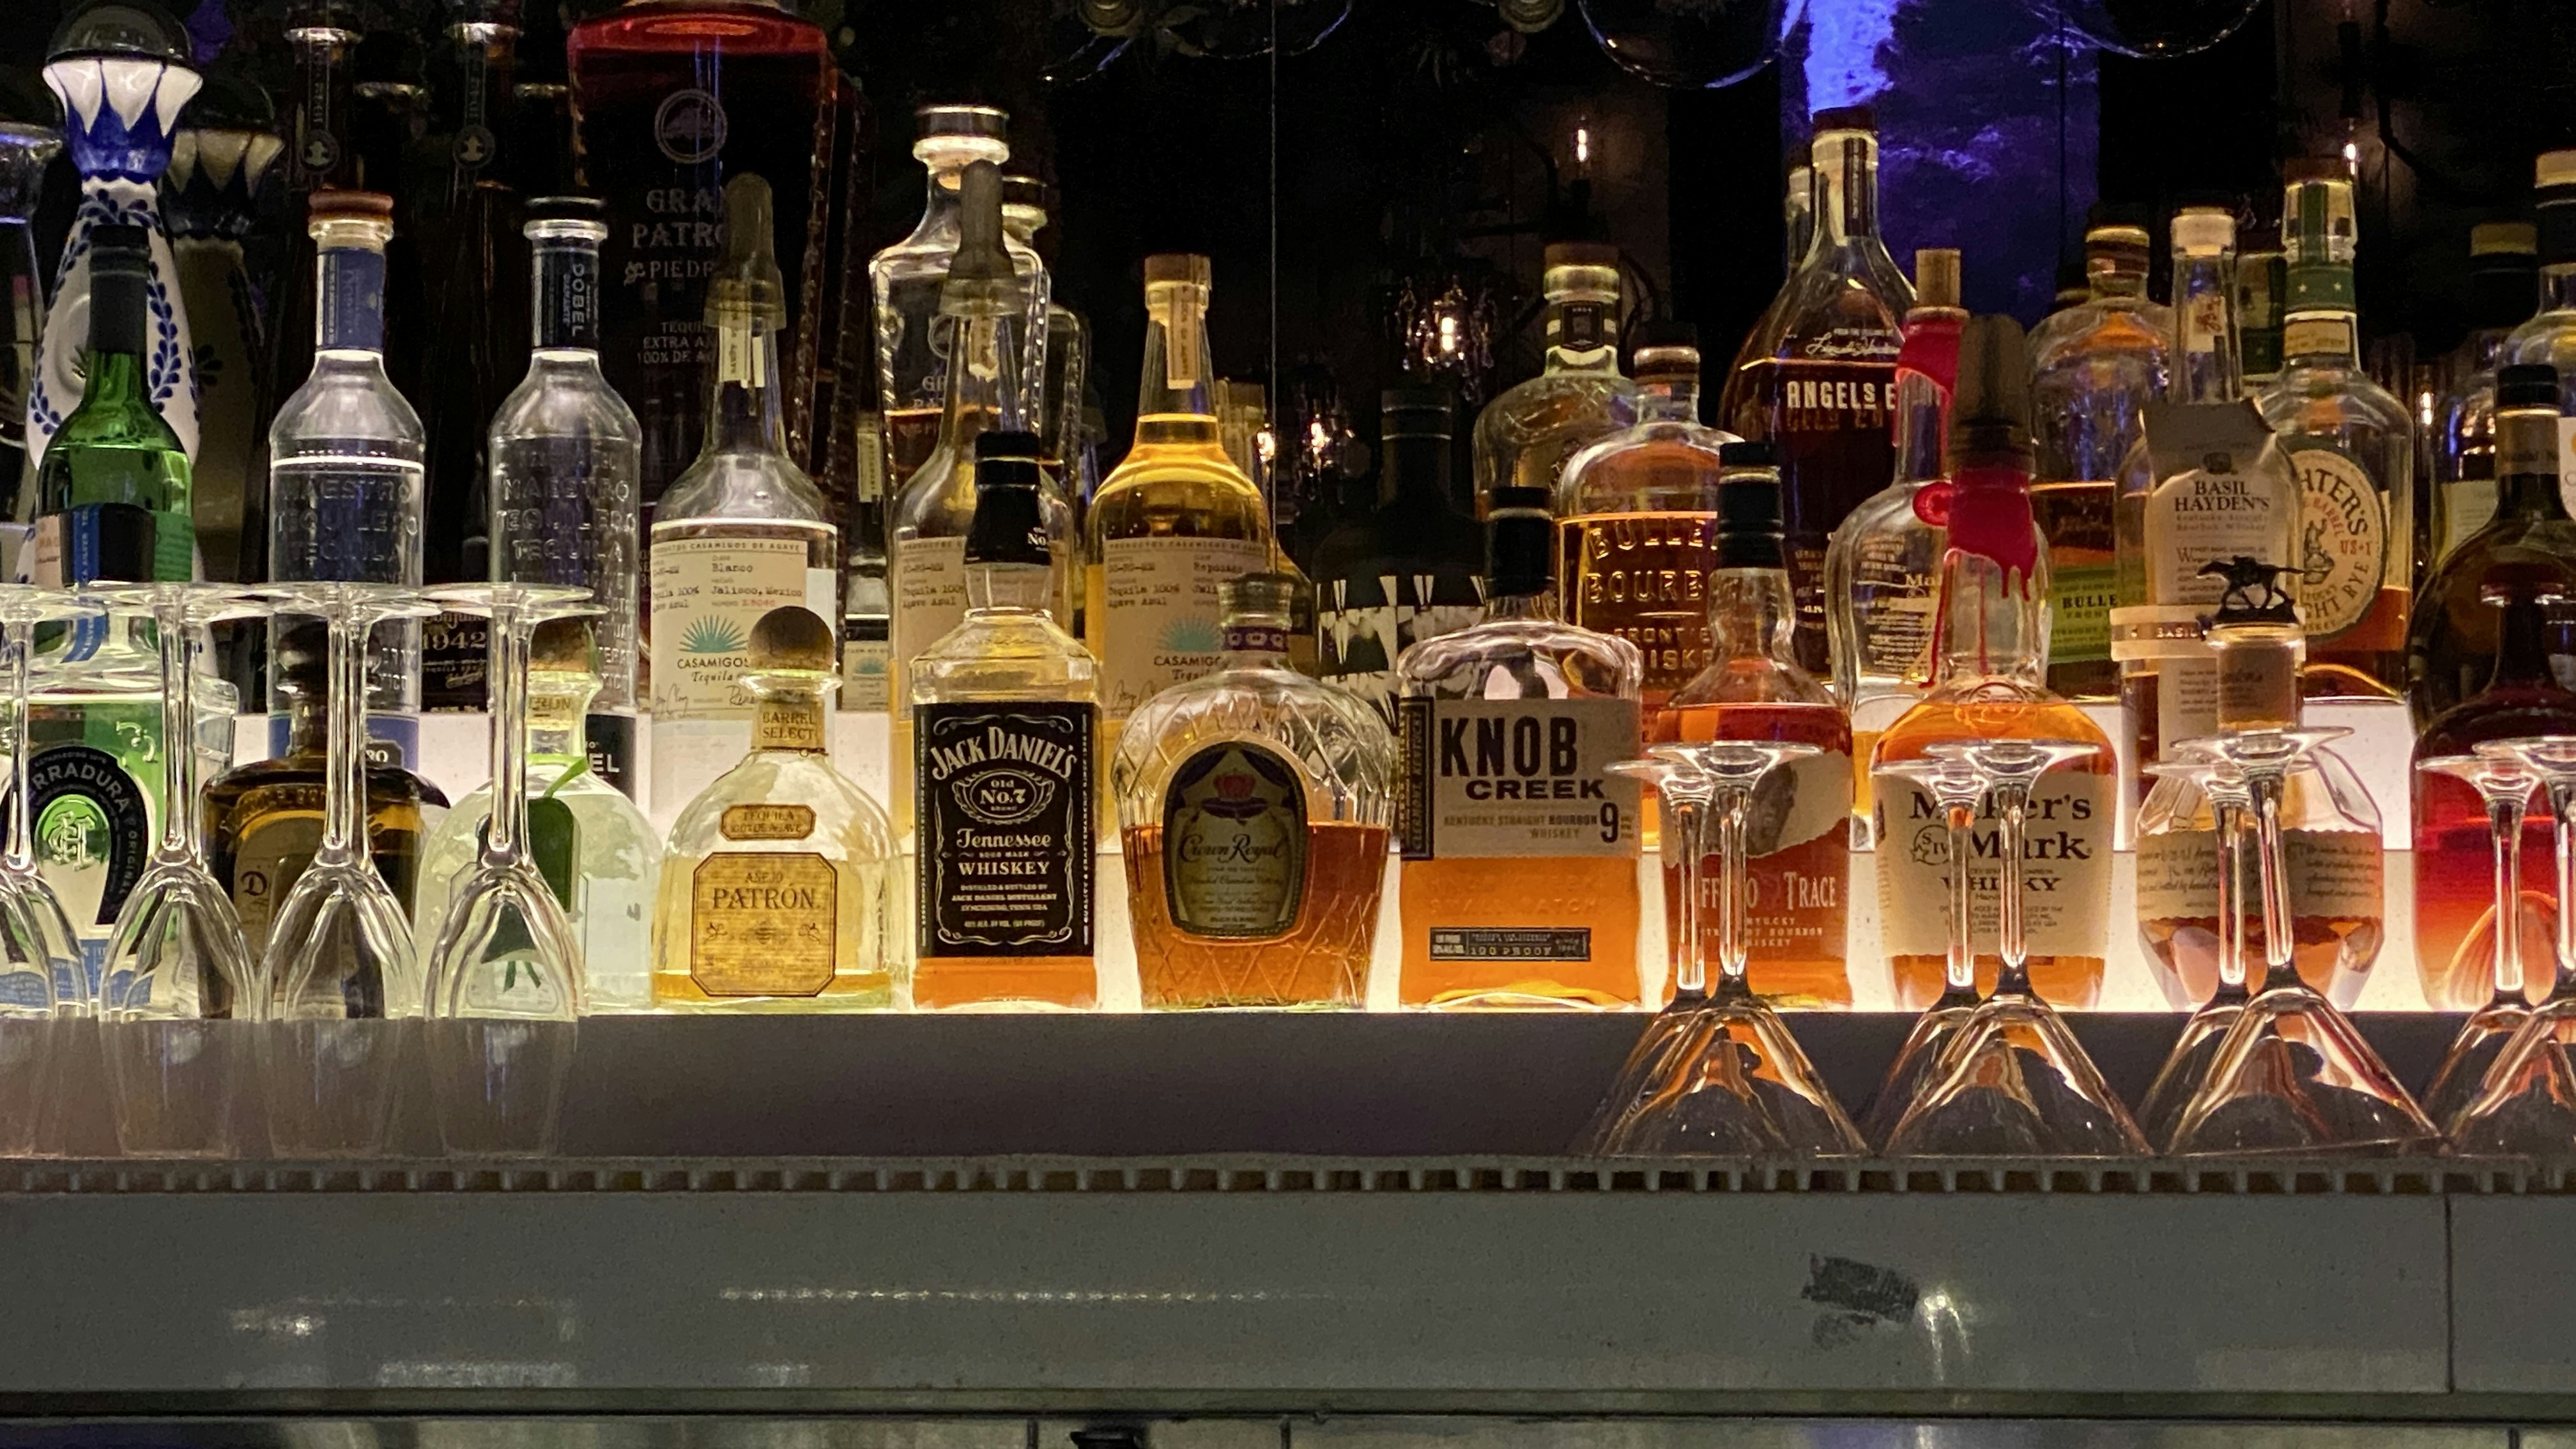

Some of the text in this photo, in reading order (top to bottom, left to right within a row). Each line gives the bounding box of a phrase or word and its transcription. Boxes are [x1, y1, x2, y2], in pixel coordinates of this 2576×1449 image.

[572, 263, 585, 337] DOBEL
[643, 337, 689, 349] EXTRA
[1787, 381, 1876, 410] ANGELS
[2195, 480, 2250, 496] BASIL
[2175, 496, 2270, 512] HAYDEN'S
[1589, 519, 1706, 560] BULLE
[711, 563, 754, 572] Blanco
[2342, 561, 2370, 599] RYE
[710, 586, 803, 597] Jalisco, Mexico
[1153, 583, 1180, 594] 100%
[422, 631, 487, 651] 1942
[692, 671, 733, 684] Tequila
[762, 712, 815, 724] BARREL
[762, 727, 815, 740] SELECT
[930, 726, 1078, 781] JACK DANIEL'S
[1441, 715, 1577, 778] KNOB
[990, 779, 1015, 788] Old
[1466, 779, 1605, 801] CREEK
[979, 788, 1026, 805] No.7
[743, 811, 795, 822] TEQUILA
[1443, 815, 1598, 825] KENTUCKY STRAIGHT BOURBON
[1599, 802, 1619, 843] 9
[956, 828, 1052, 848] Tennessee
[1531, 828, 1580, 839] WHISKEY
[1179, 832, 1282, 863] Crown Royal
[958, 861, 1050, 875] WHISKEY
[1783, 871, 1836, 911] TRACE
[1940, 877, 2062, 891] HIKY
[712, 883, 815, 910] PATRÓN
[1769, 928, 1823, 937] BOURBON
[1470, 946, 1552, 956] 100 PROOF
